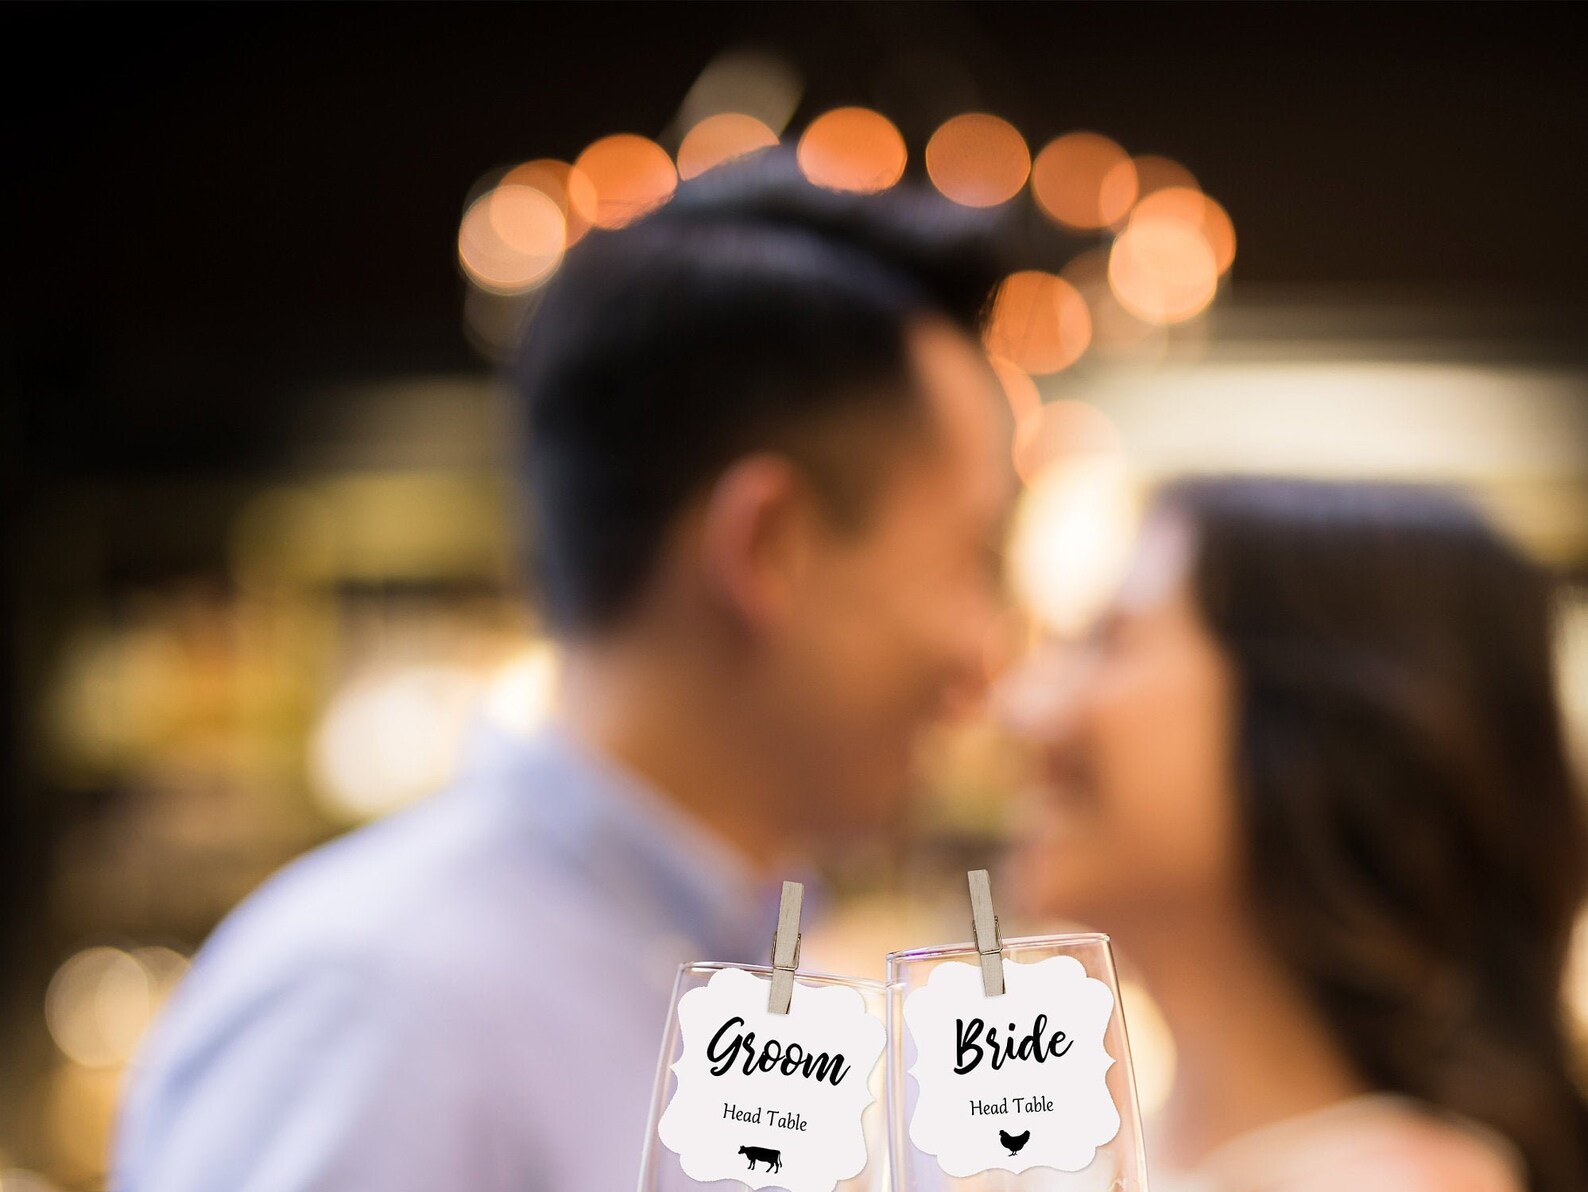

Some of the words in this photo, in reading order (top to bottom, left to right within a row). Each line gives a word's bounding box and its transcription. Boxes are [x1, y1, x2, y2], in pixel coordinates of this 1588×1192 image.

[706, 1016, 852, 1087] Groom
[953, 1013, 1074, 1076] Bride
[723, 1102, 762, 1125] Head
[766, 1110, 808, 1132] Table
[969, 1097, 1009, 1116] Head
[1012, 1095, 1054, 1114] Table
